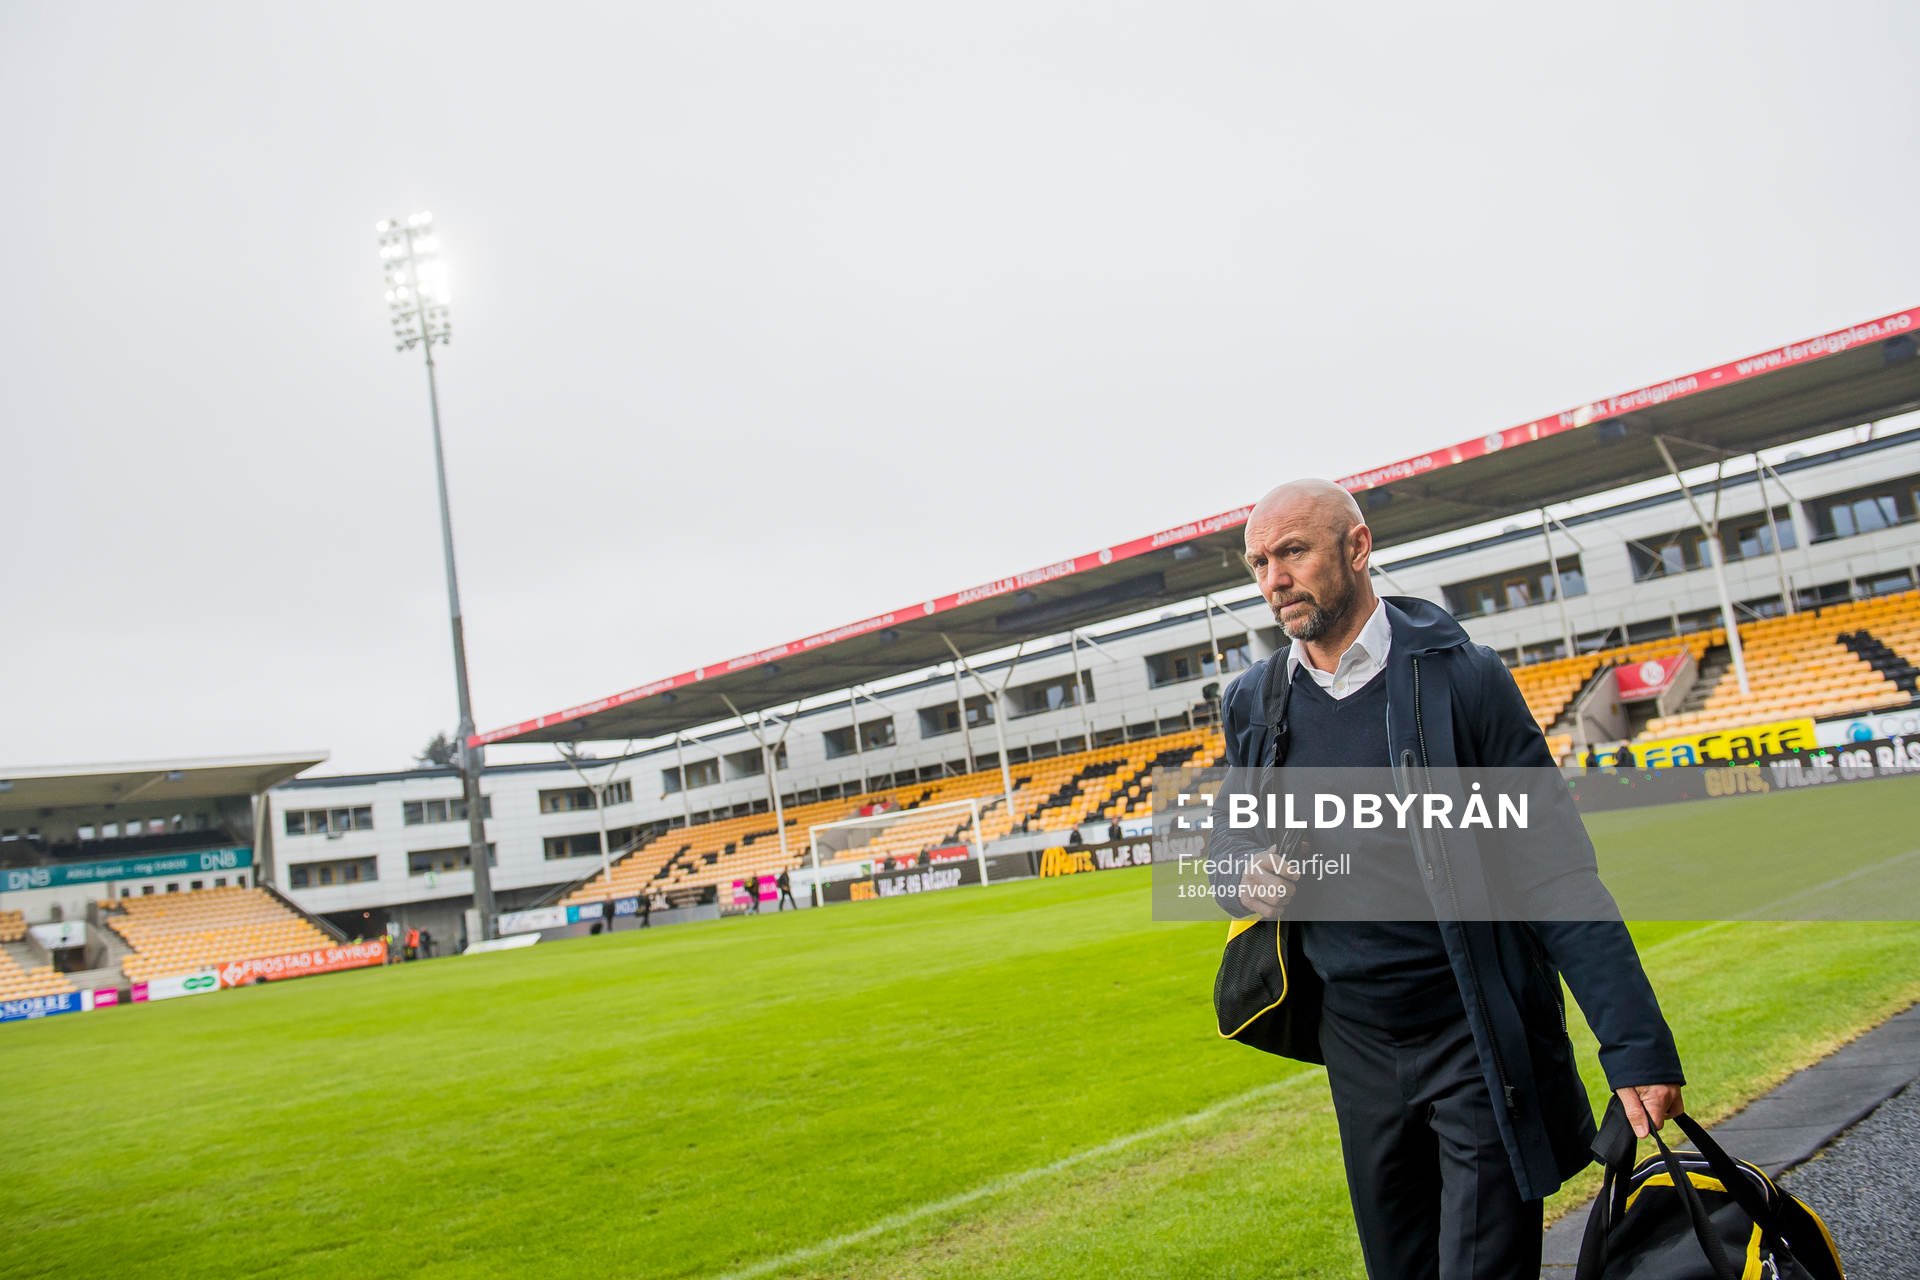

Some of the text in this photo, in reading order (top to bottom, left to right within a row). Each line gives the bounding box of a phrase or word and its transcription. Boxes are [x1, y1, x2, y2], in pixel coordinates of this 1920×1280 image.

[1770, 753, 1838, 788] VILJE
[1838, 749, 1875, 781] OG
[200, 848, 237, 871] DNB
[8, 866, 51, 890] DNB
